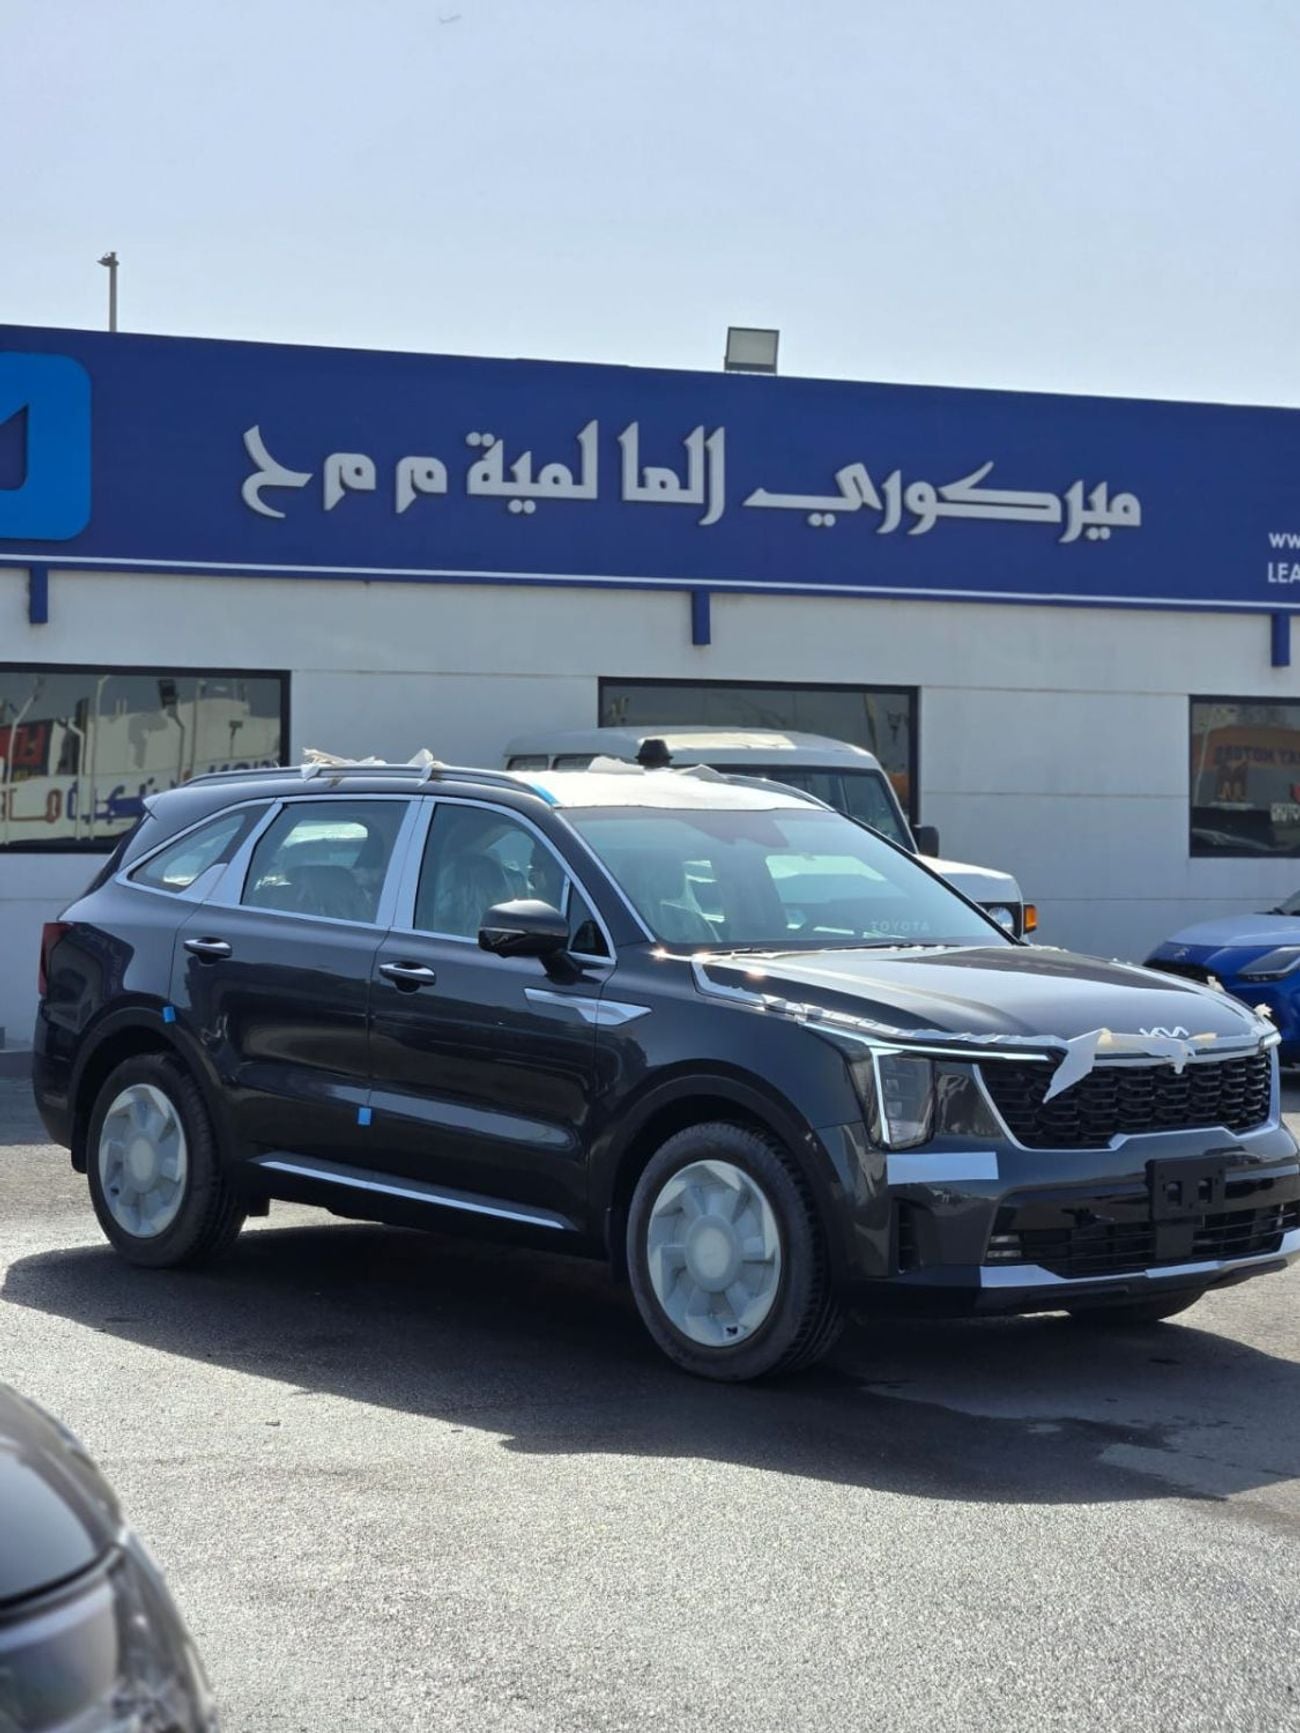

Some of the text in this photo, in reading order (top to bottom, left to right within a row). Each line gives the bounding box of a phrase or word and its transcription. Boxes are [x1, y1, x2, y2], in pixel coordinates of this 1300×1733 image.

[242, 425, 313, 518] ح
[324, 452, 376, 511] م
[396, 456, 448, 513] م
[743, 461, 1142, 543] ميركوري
[871, 919, 930, 932] TOYOTA
